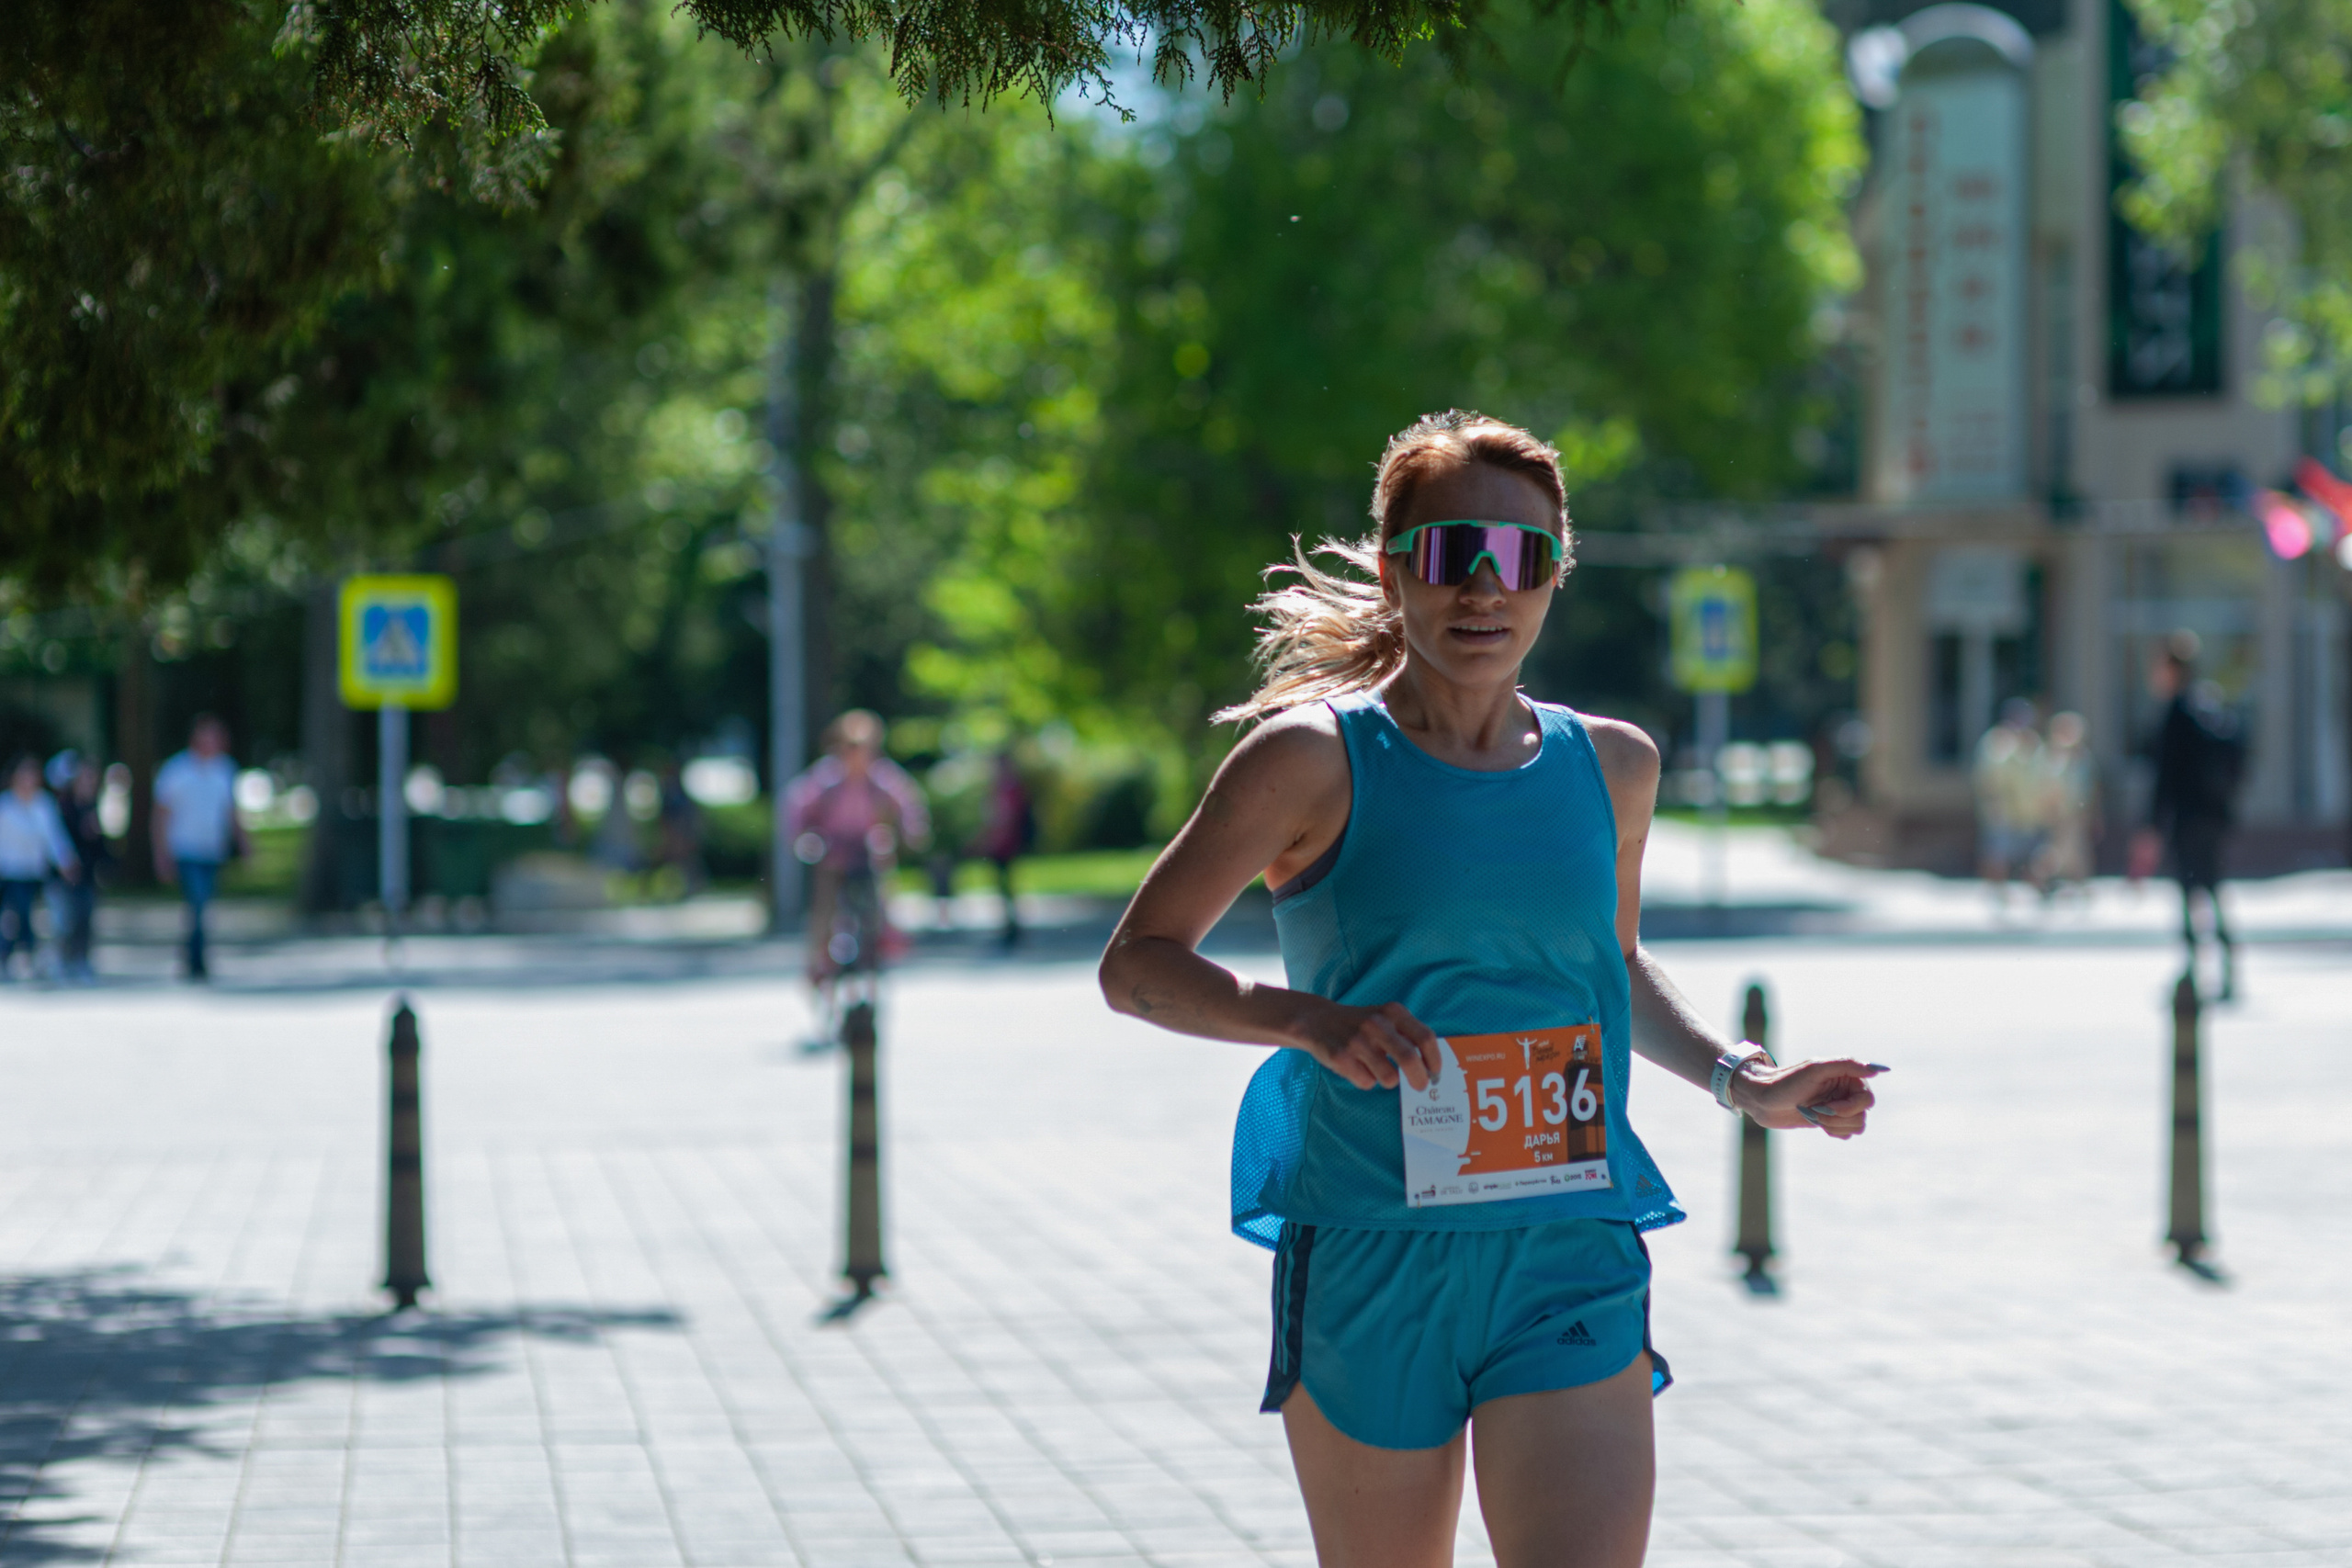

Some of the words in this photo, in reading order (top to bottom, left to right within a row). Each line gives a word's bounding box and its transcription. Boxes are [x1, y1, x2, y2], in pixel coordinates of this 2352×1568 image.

[1476, 1068, 1598, 1133] 5136
[1416, 1105, 1455, 1115] Château
[1408, 1113, 1464, 1126] TAMAGNE
[1523, 1132, 1561, 1149] ДАРЬЯ
[1533, 1151, 1541, 1163] 5
[1556, 1337, 1597, 1347] adidas
